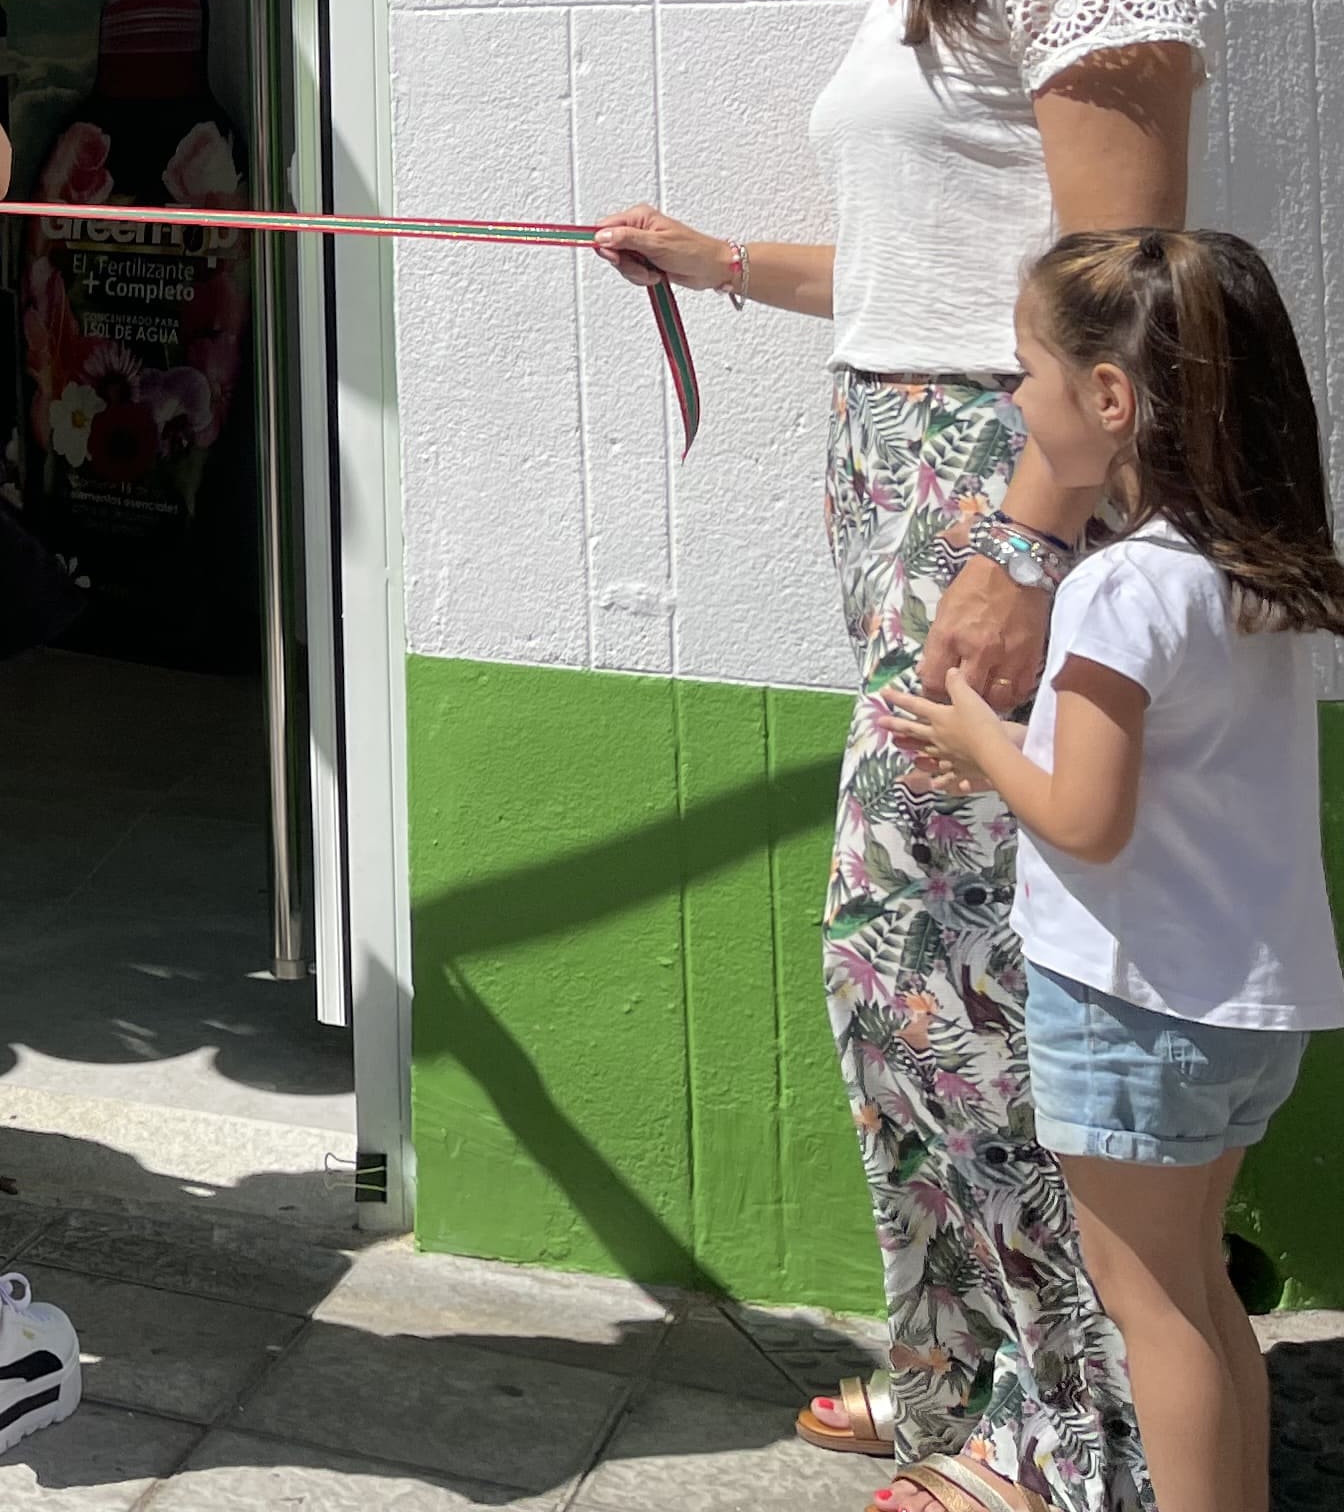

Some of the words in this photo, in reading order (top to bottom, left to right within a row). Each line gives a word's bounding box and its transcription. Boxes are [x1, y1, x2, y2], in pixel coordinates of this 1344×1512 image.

[98, 255, 195, 283] Fertilizante
[105, 277, 196, 305] Completo
[115, 325, 134, 342] DE
[136, 328, 180, 346] AGUA
